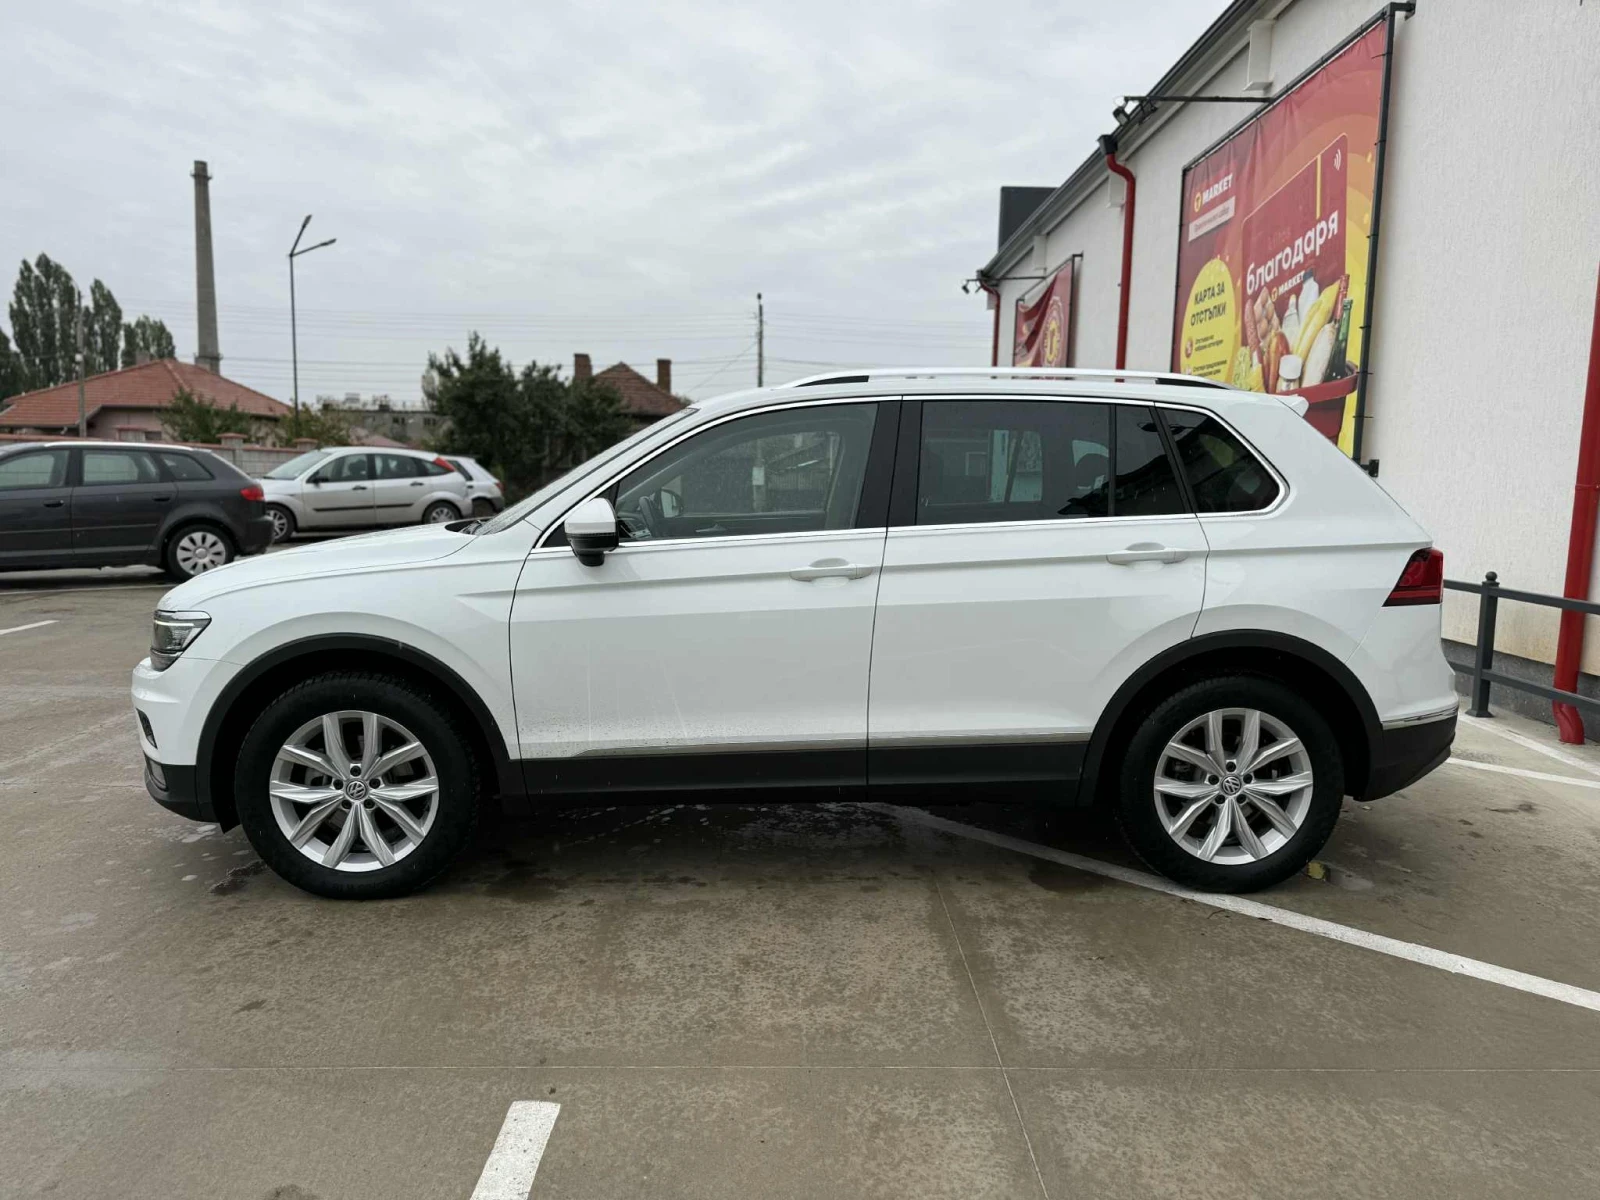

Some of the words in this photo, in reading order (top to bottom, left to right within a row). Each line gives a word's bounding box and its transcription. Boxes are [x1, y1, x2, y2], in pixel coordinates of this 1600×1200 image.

[1202, 172, 1233, 206] MARKET
[1246, 209, 1339, 296] благодаря
[1194, 285, 1216, 306] КАРТА
[1216, 281, 1226, 297] ЗА
[1278, 270, 1306, 296] MARKET
[1190, 301, 1227, 326] ОТСТЪПКИ
